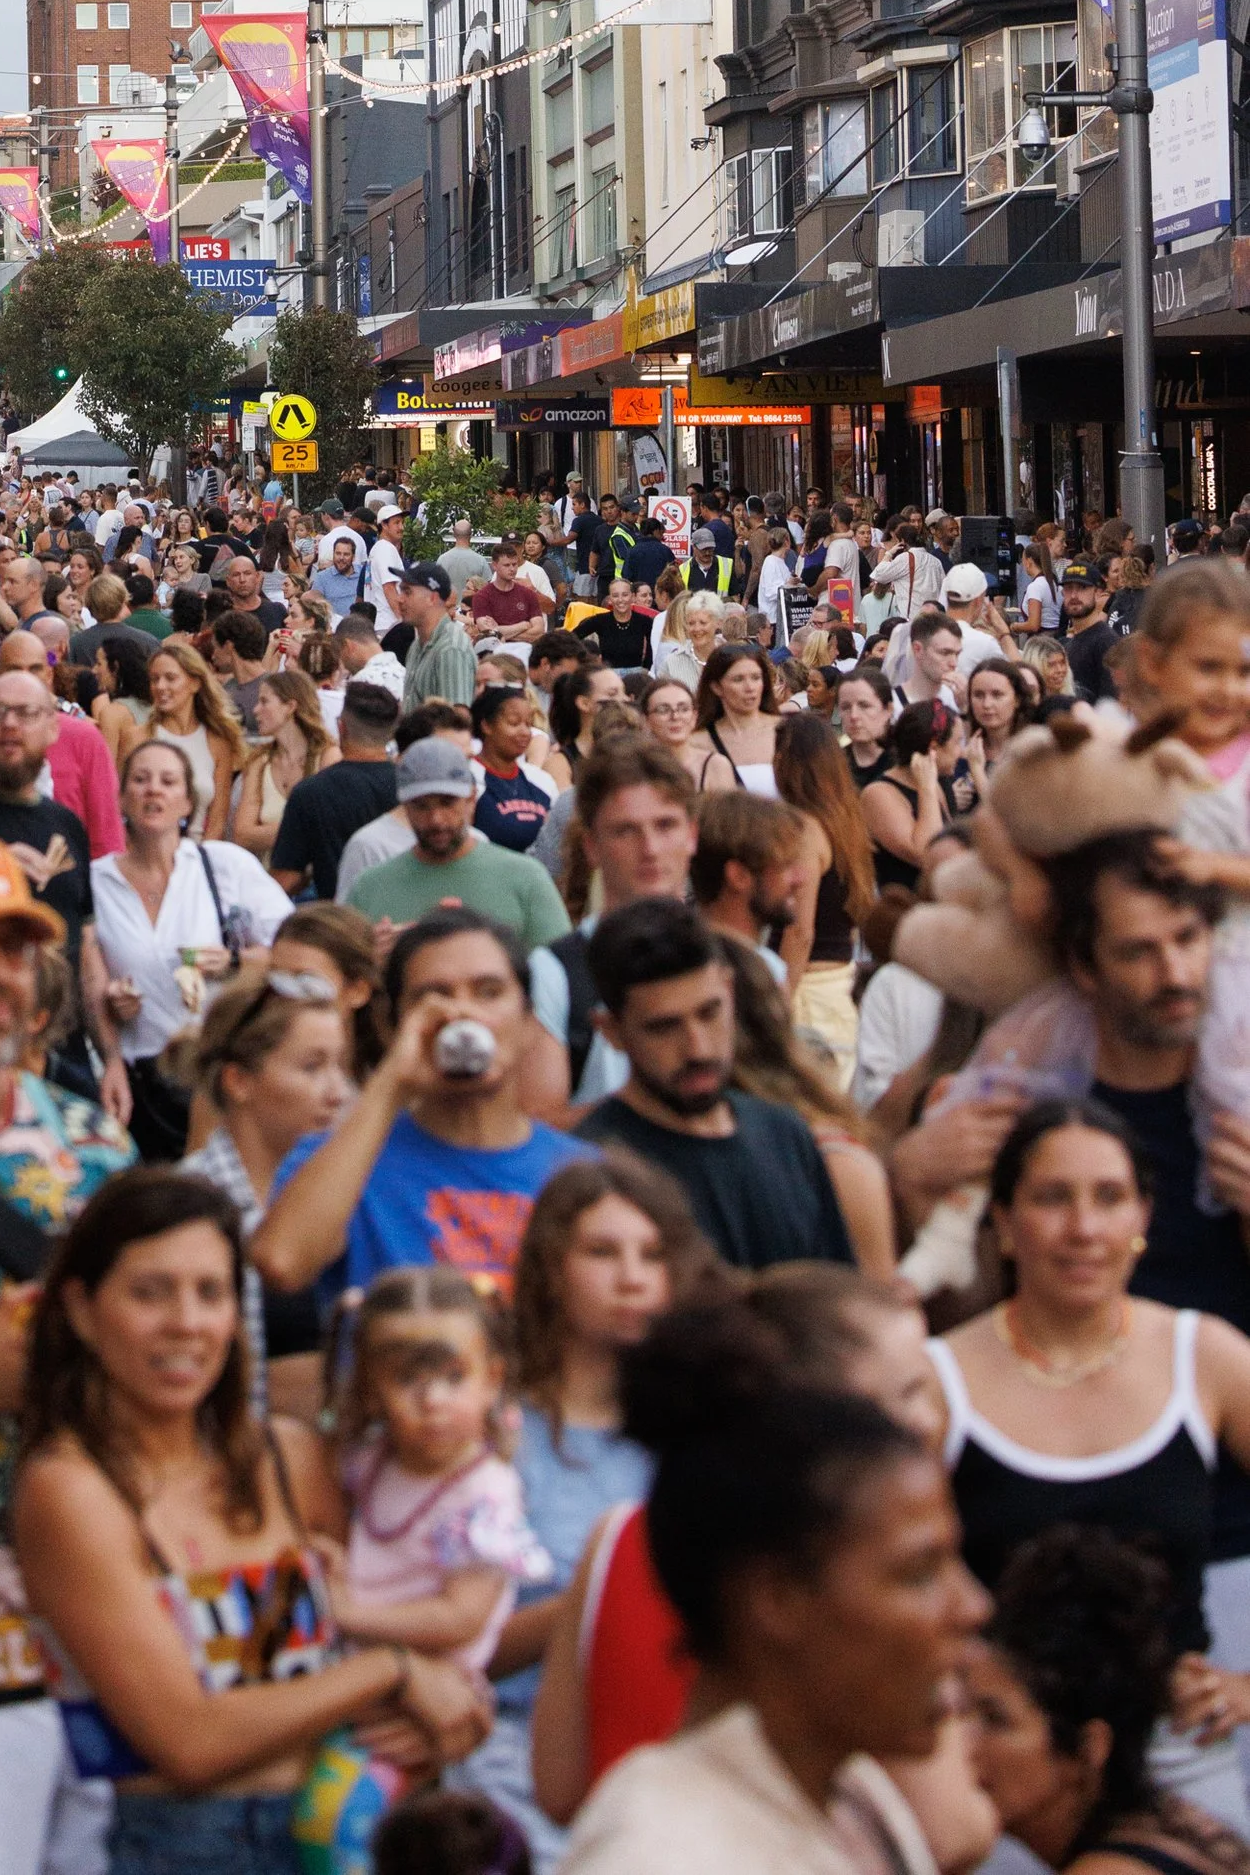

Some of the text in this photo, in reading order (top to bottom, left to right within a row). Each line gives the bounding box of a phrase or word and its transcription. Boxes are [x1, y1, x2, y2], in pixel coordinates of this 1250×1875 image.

[184, 243, 222, 259] LIE'S
[180, 269, 266, 287] HEMIST
[431, 380, 493, 396] coogee
[545, 409, 606, 421] amazon
[688, 414, 700, 423] OR
[701, 414, 743, 424] TAKEAWAY
[282, 444, 309, 461] 25
[1206, 450, 1216, 511] COCKTAIL BAR
